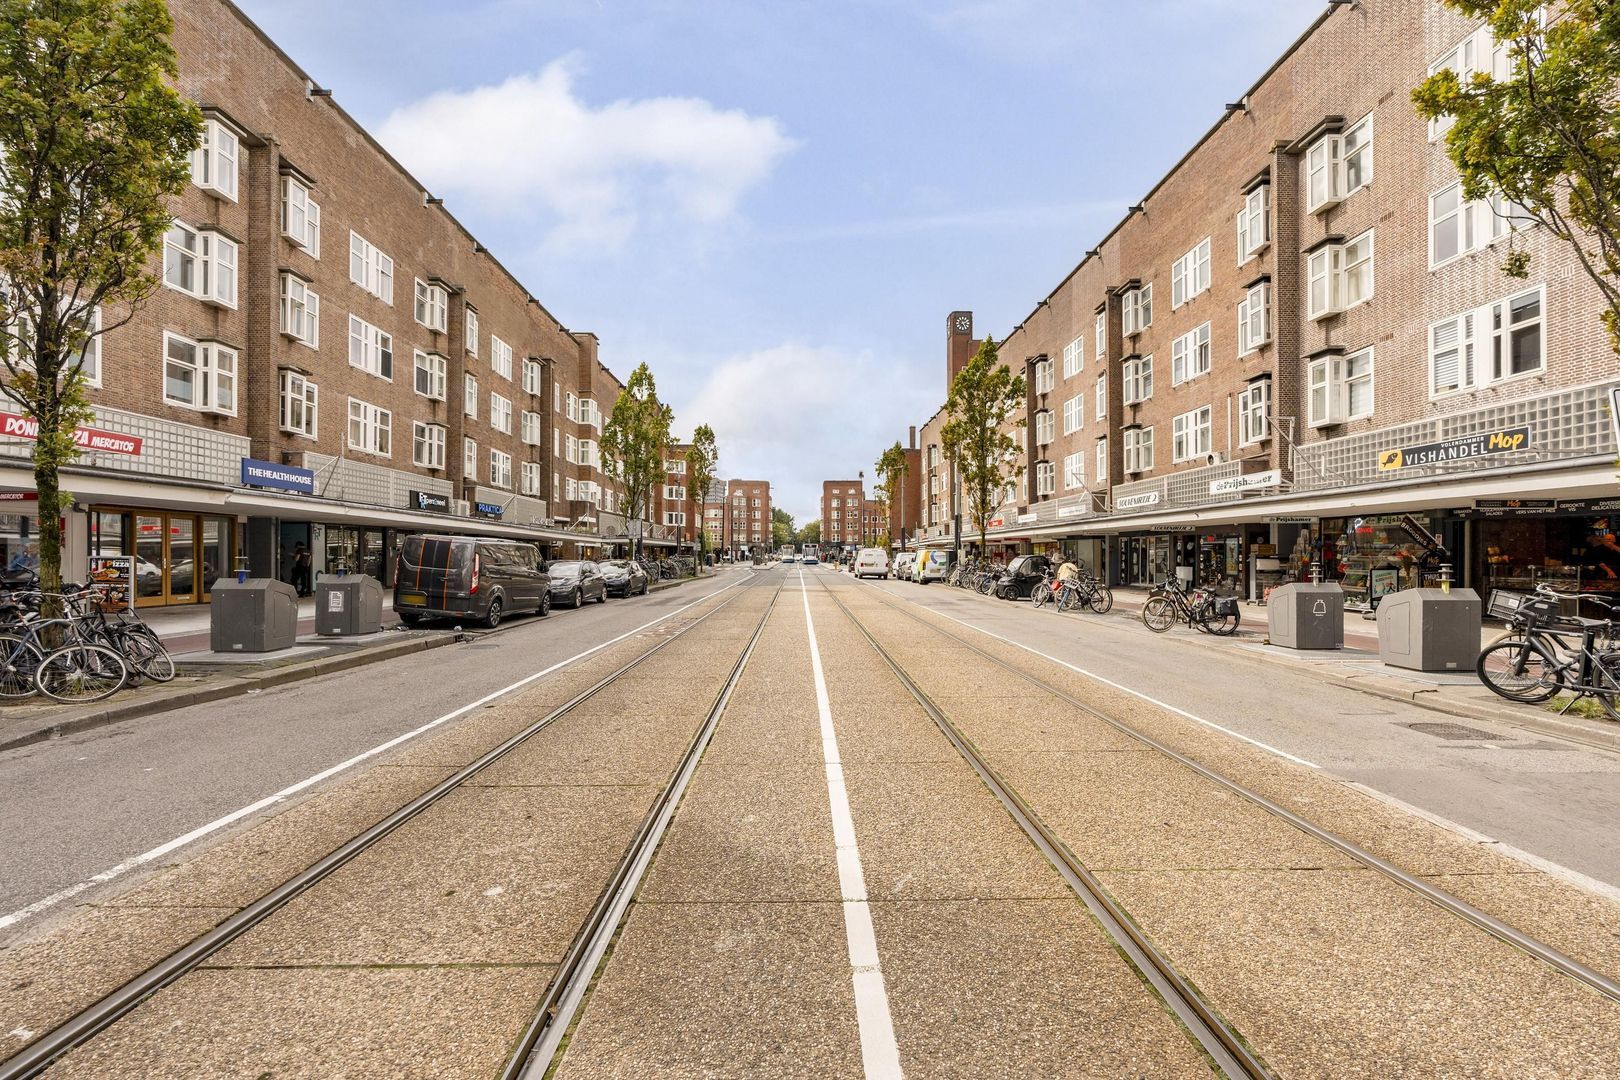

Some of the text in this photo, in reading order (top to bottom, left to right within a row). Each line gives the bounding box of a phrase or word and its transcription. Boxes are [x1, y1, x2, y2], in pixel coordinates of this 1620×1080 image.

[5, 417, 39, 436] DON
[91, 436, 135, 452] MERCATOR
[1405, 433, 1524, 465] VISHANDEL Mop
[1440, 437, 1485, 447] VOLENDAMMER
